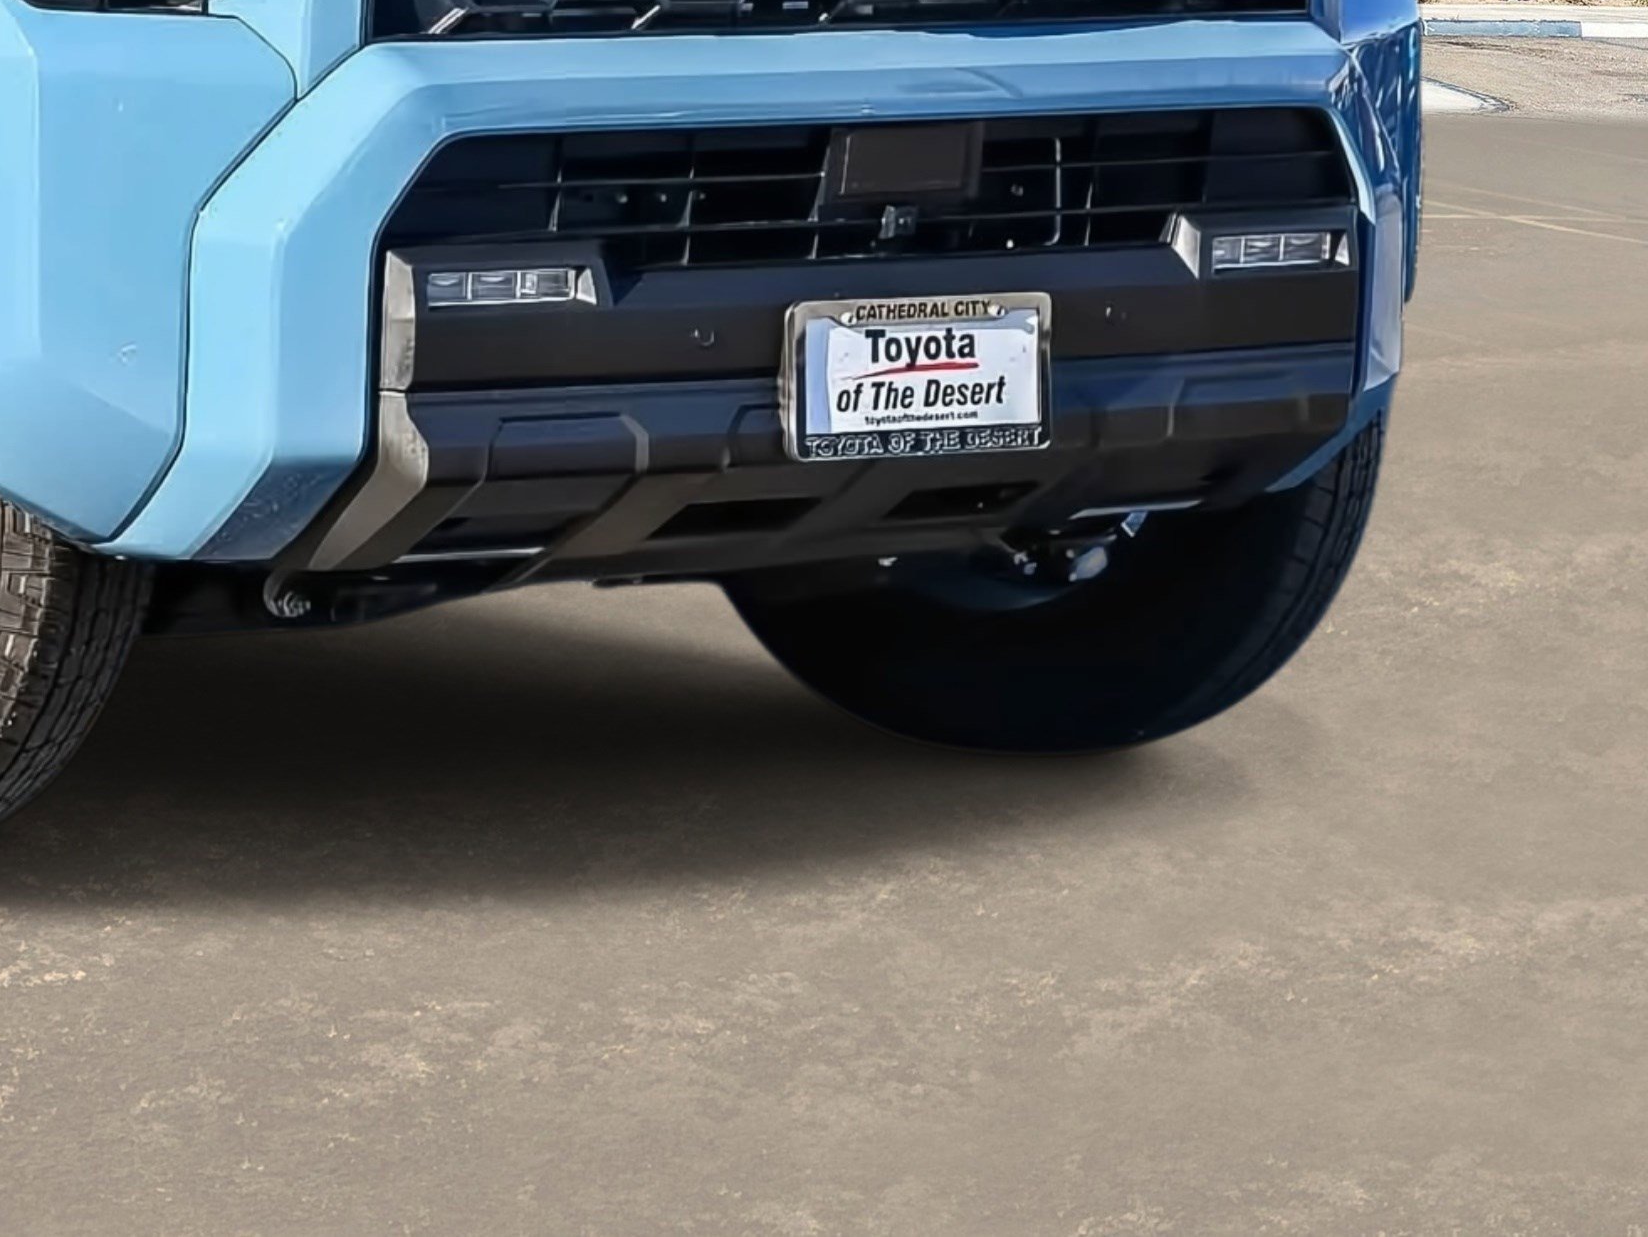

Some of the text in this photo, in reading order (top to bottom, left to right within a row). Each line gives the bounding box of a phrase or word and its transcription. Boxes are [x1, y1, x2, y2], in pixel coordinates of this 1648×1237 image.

[855, 300, 991, 321] CATHEDRAL CITY
[864, 327, 975, 369] Toyota
[836, 375, 1007, 413] of The Desert
[805, 426, 1042, 457] TOYOTA OF THE DESERT
